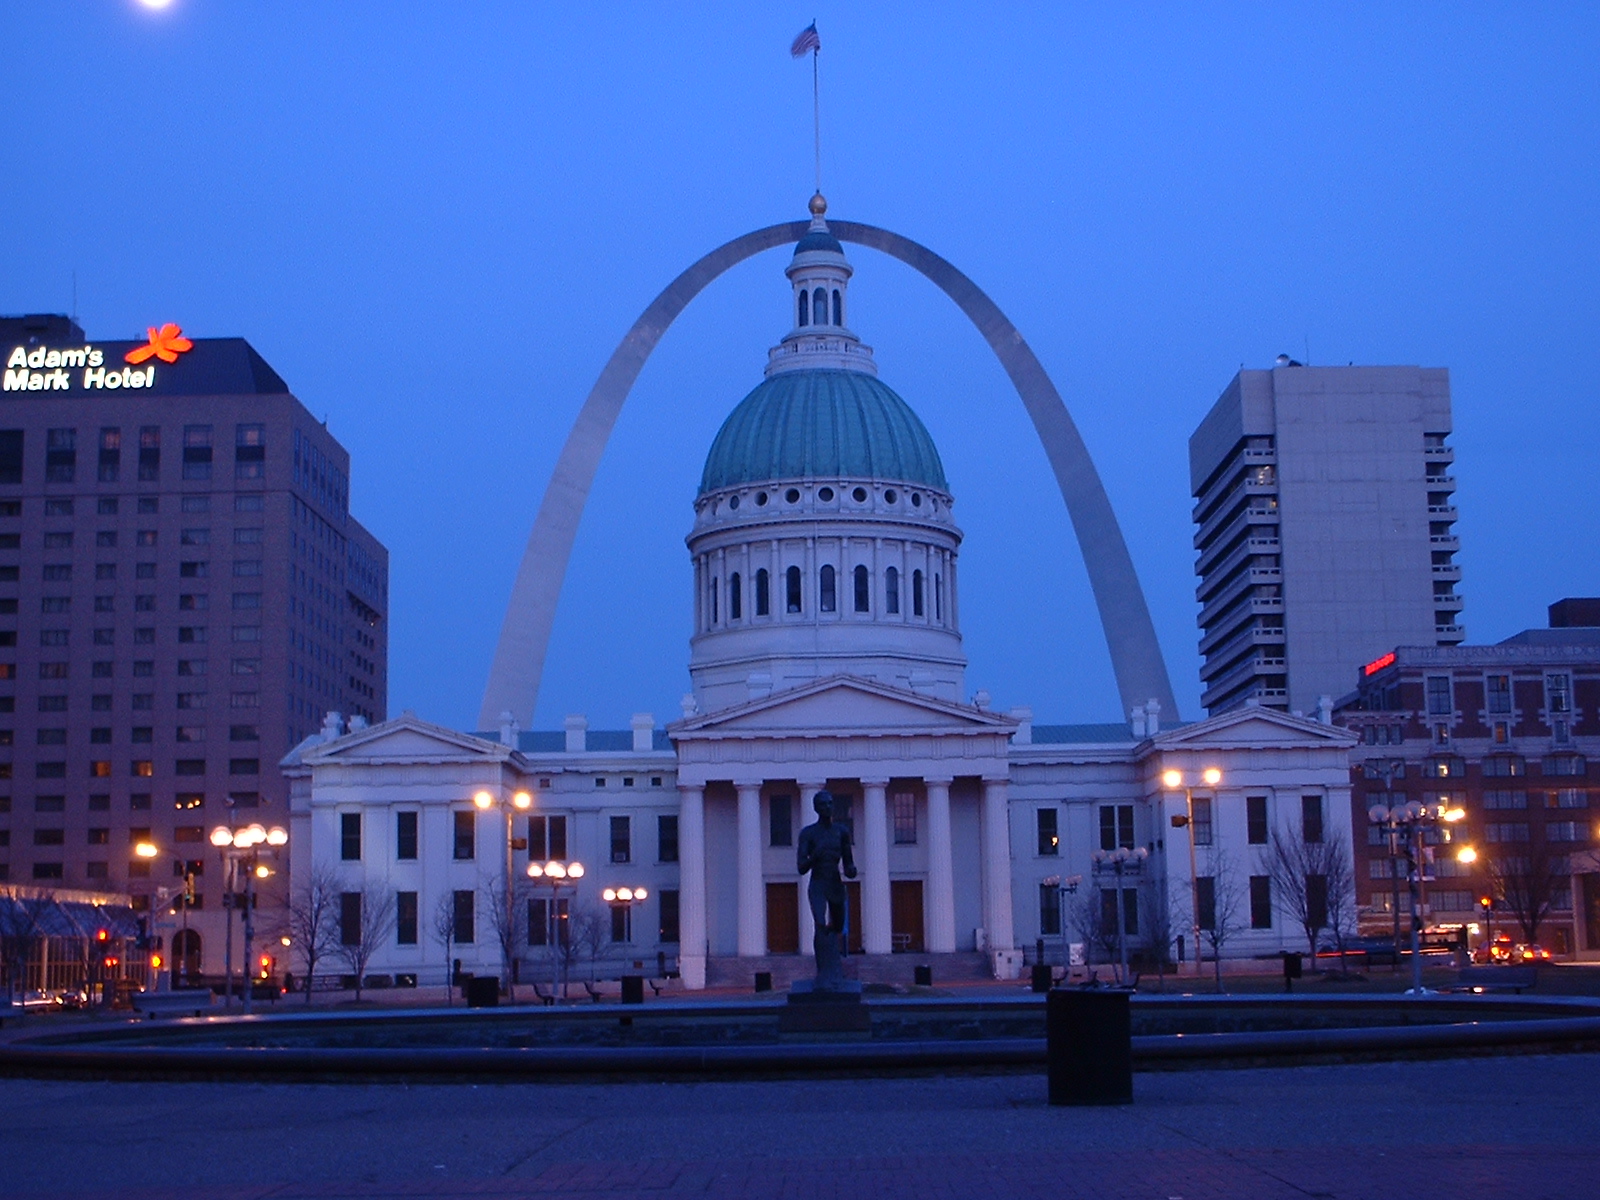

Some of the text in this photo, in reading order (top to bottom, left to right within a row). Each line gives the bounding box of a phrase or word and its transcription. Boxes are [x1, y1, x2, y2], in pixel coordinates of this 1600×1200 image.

[7, 345, 104, 369] Adam's
[3, 366, 155, 391] Mark Hotel
